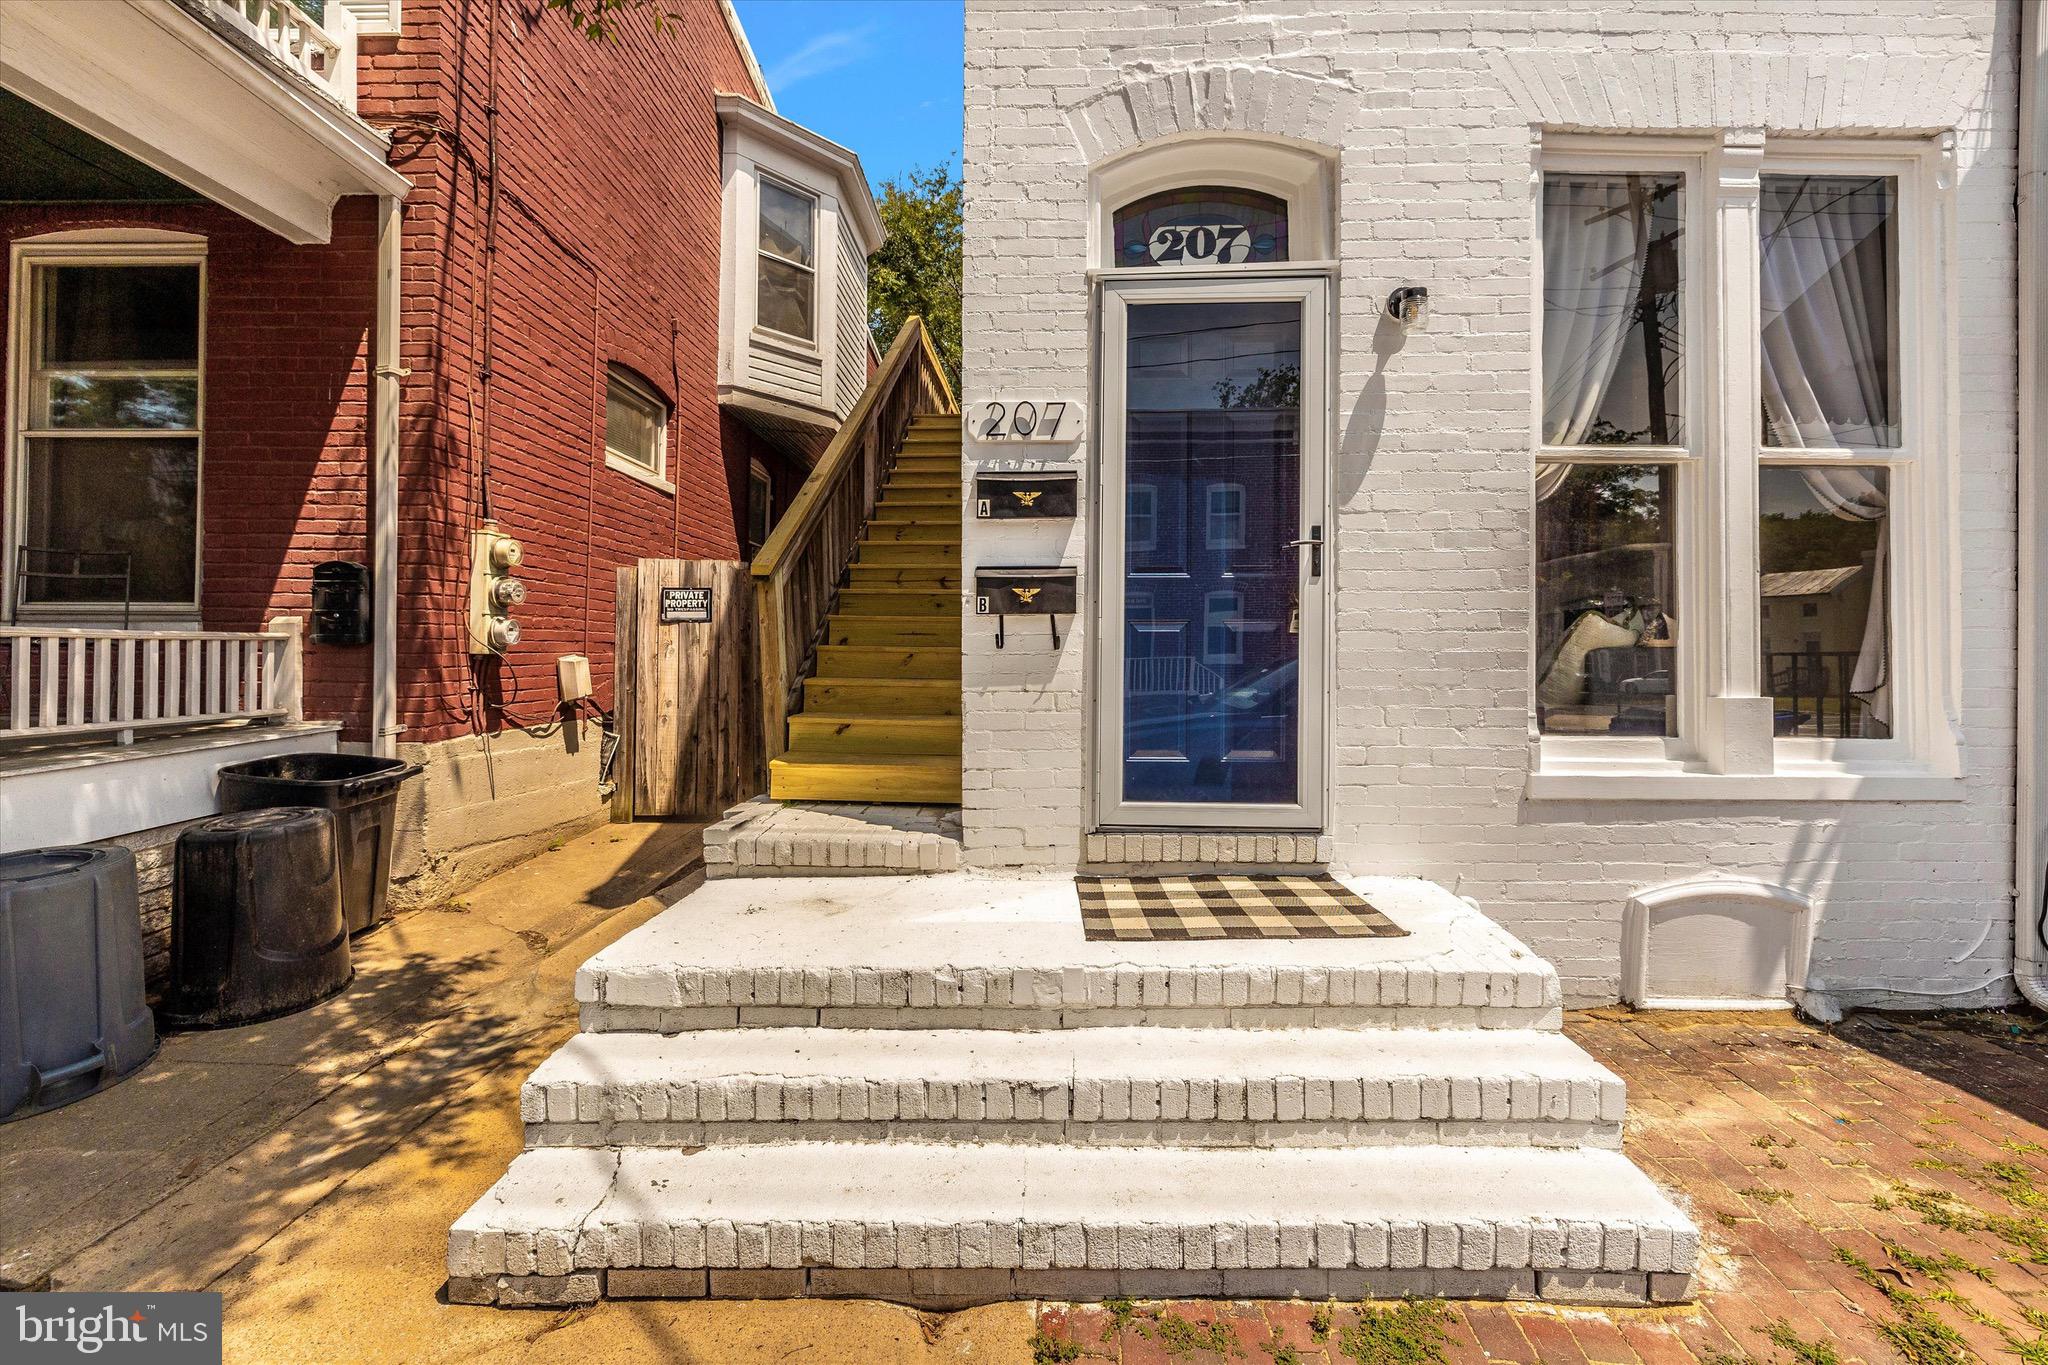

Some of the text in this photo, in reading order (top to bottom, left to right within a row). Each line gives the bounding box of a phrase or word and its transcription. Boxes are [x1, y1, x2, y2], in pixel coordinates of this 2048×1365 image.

[1156, 227, 1247, 264] 207
[986, 401, 1066, 437] 207
[979, 501, 989, 517] A
[665, 599, 708, 608] PROPERTY
[669, 591, 704, 600] PRIVATE
[979, 597, 987, 613] B
